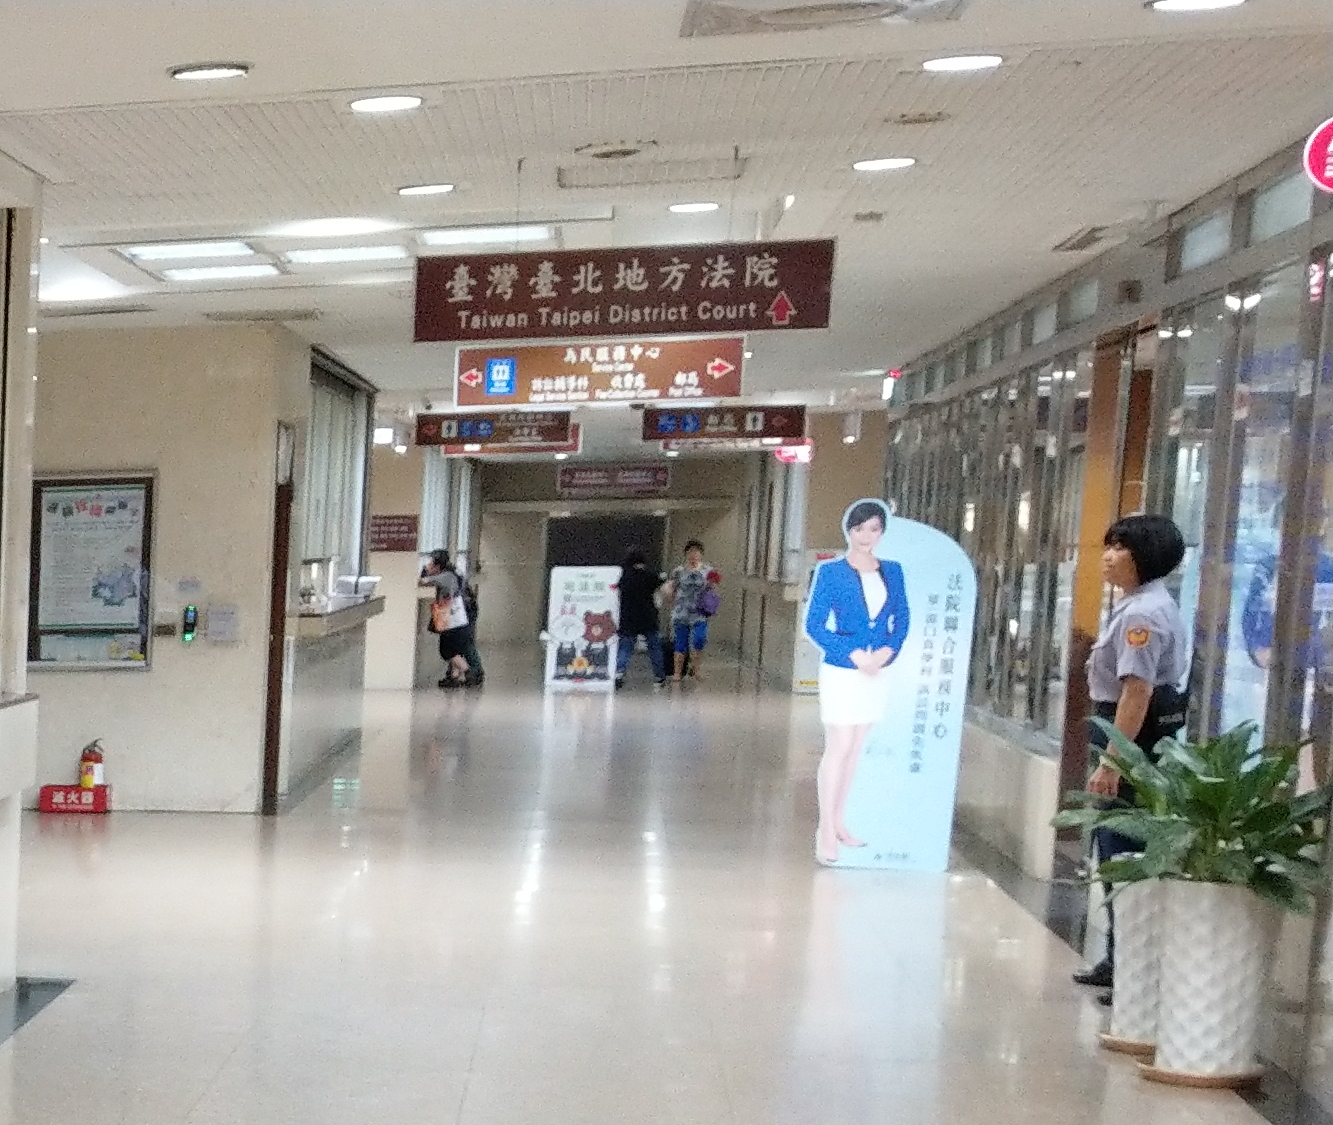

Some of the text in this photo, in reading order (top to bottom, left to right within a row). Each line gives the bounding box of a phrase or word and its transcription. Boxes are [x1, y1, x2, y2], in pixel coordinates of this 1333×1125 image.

[445, 252, 779, 303] 臺灣臺北地方法院
[457, 300, 758, 330] Taiwan Taipei District Court
